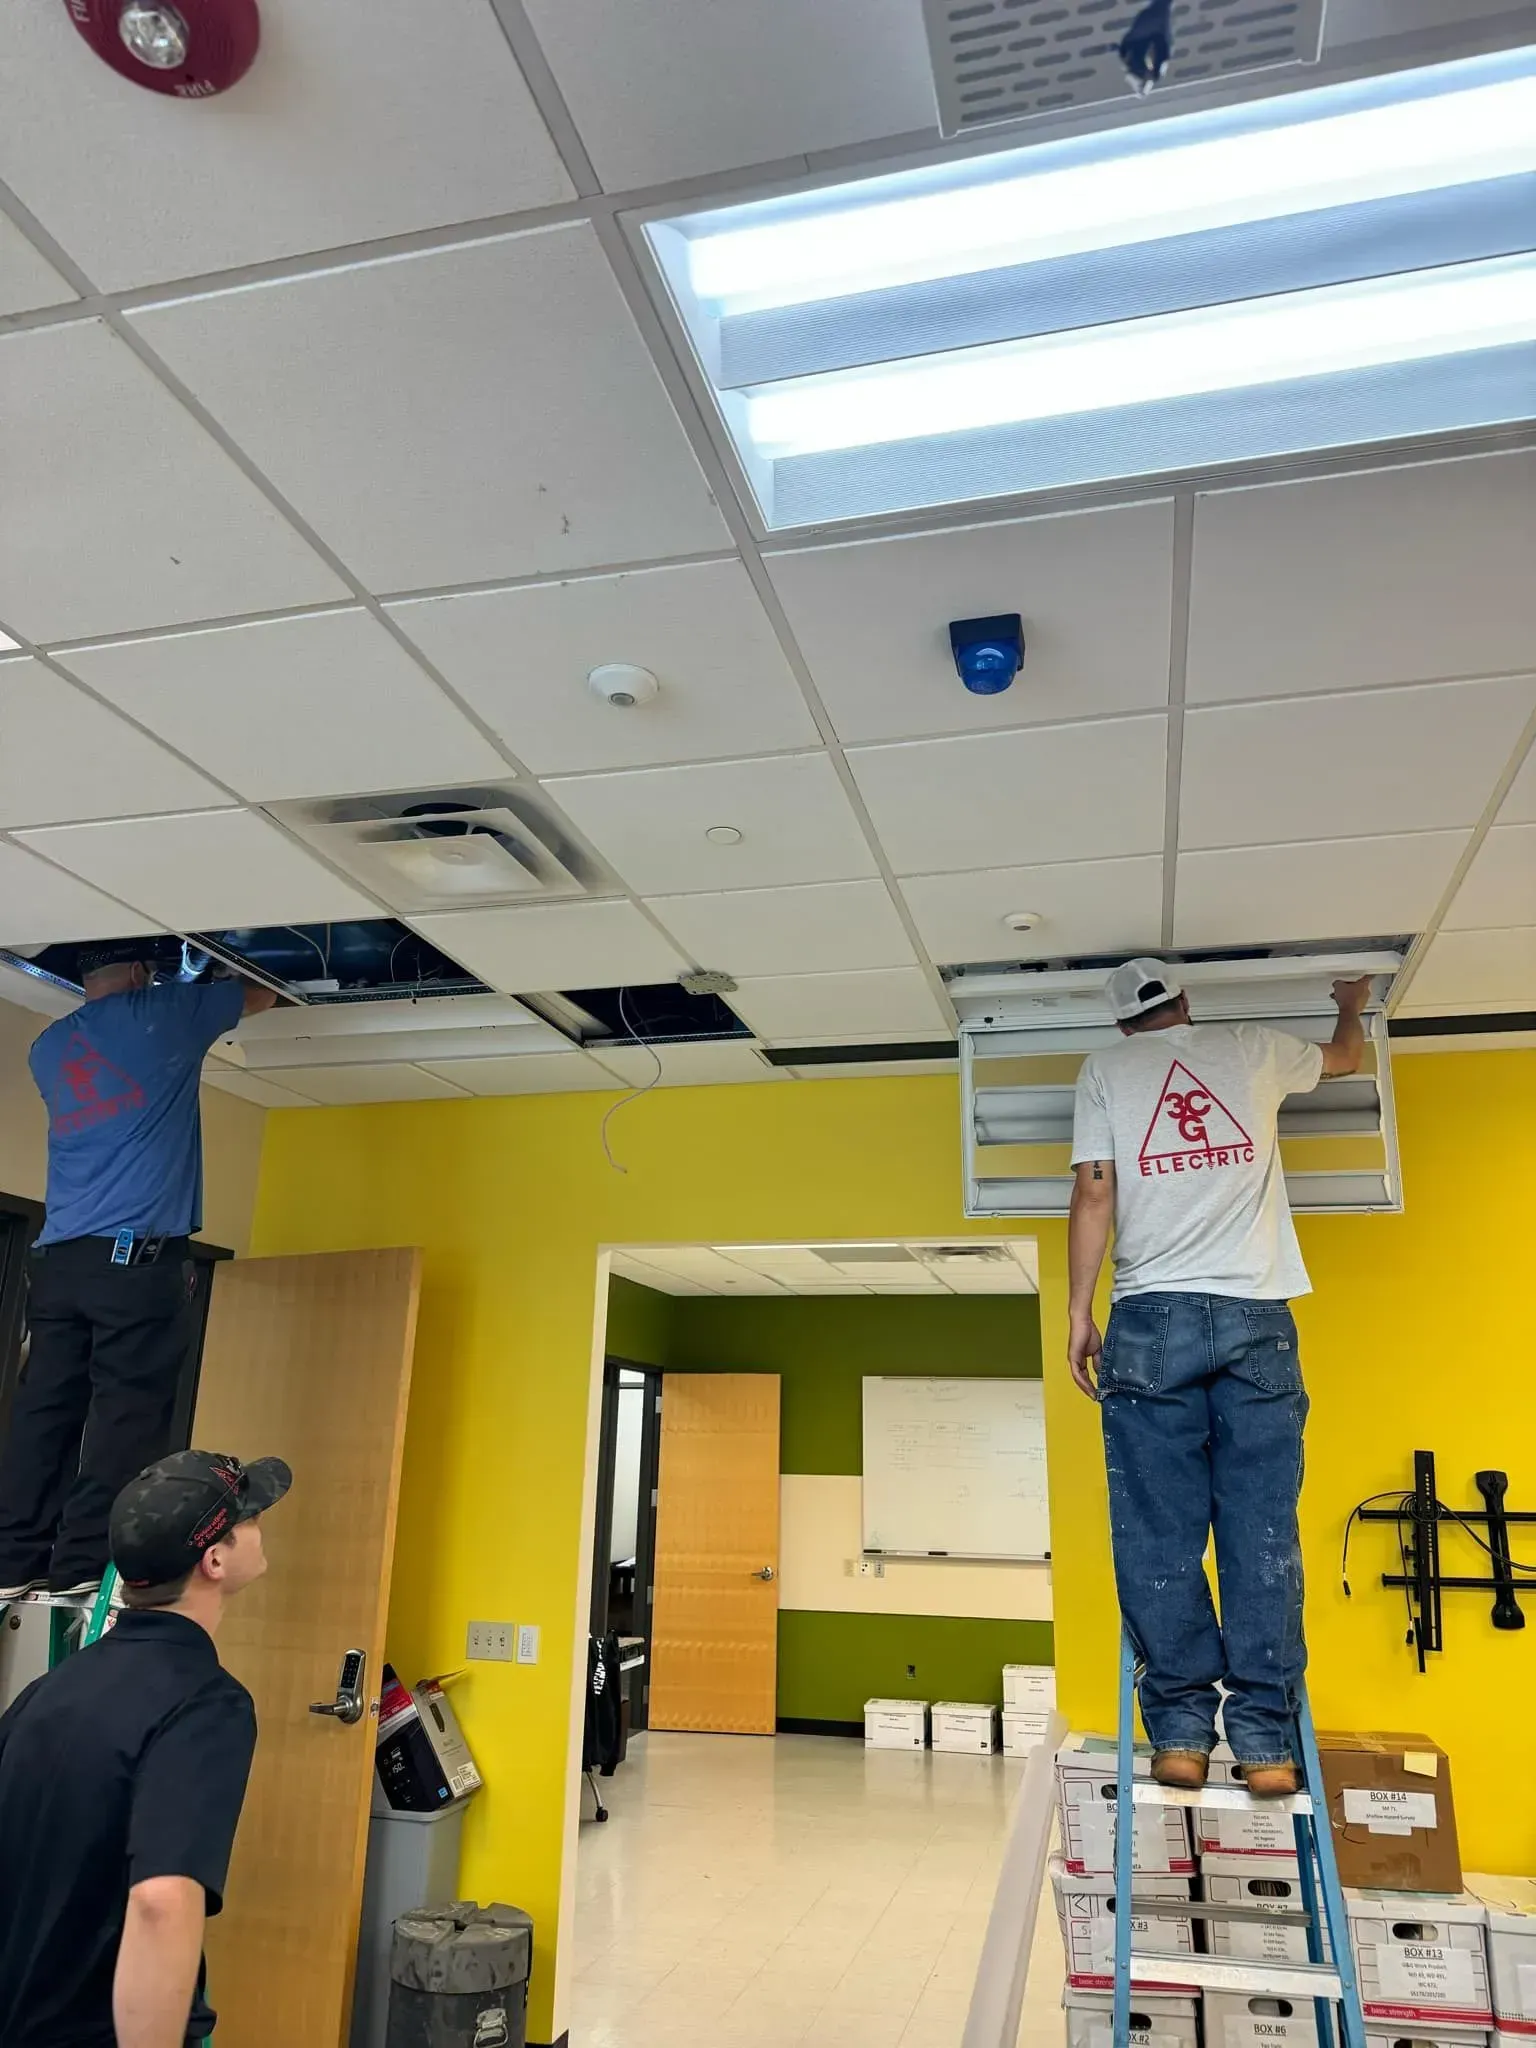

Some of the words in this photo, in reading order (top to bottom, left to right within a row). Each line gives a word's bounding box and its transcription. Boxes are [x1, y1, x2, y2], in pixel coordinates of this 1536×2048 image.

[1138, 1147, 1255, 1177] ELECTRIC
[1370, 1792, 1388, 1801] BOX
[1391, 1792, 1407, 1801] #14
[1404, 1947, 1424, 1957] BOX
[1426, 1949, 1443, 1958] #13
[1388, 2008, 1416, 2017] strength
[1254, 2024, 1273, 2034] BOX
[1275, 2025, 1287, 2034] #6
